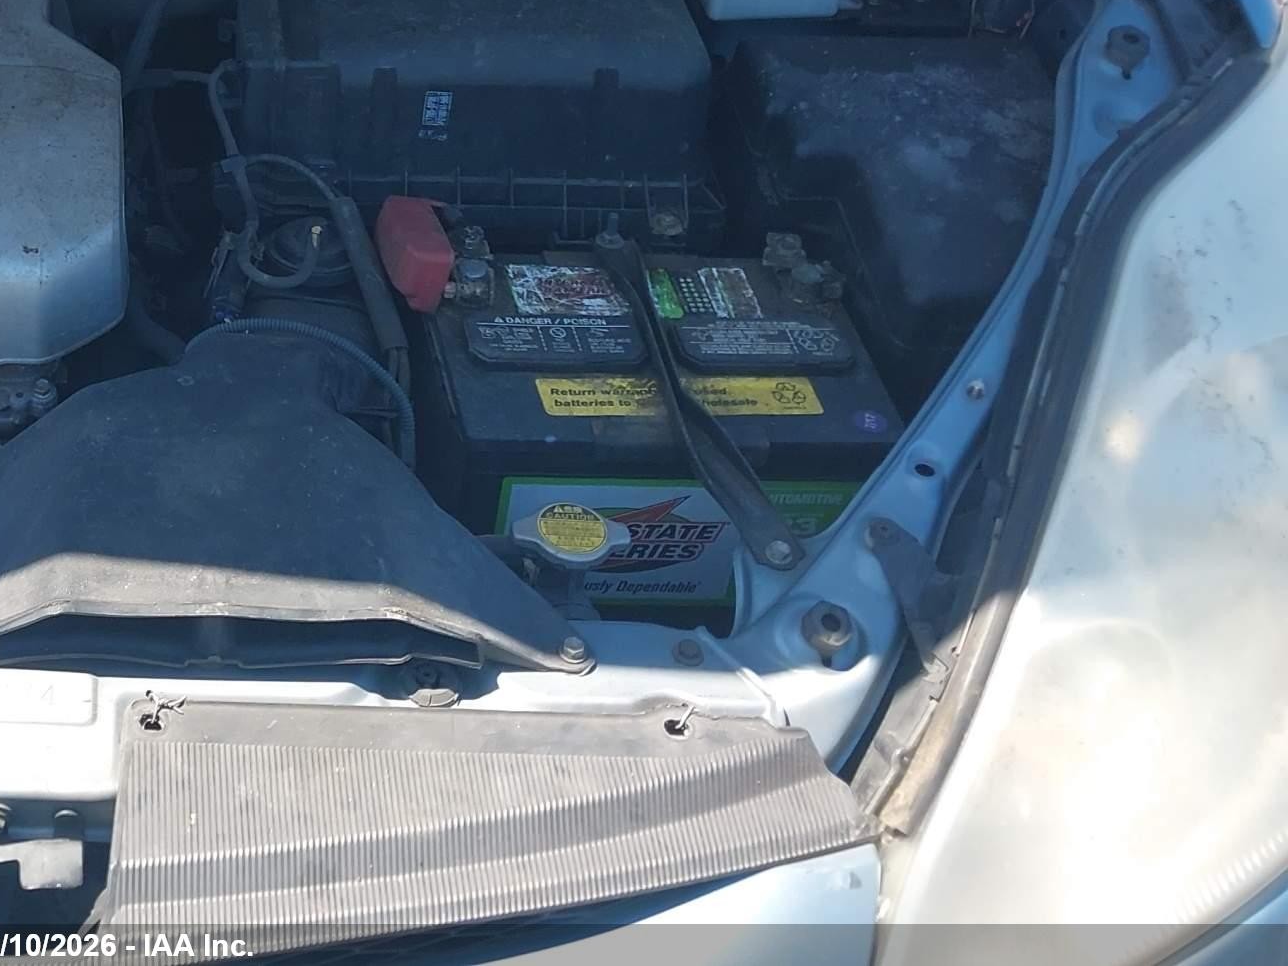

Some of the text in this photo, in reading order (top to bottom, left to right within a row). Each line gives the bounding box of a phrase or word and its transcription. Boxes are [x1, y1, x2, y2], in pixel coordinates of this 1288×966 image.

[505, 317, 552, 325] DANGER
[563, 317, 607, 326] POISON
[550, 387, 596, 396] Return
[554, 398, 614, 407] batteries
[619, 399, 632, 407] to
[546, 512, 596, 522] CAUTION
[616, 579, 698, 594] Dependable
